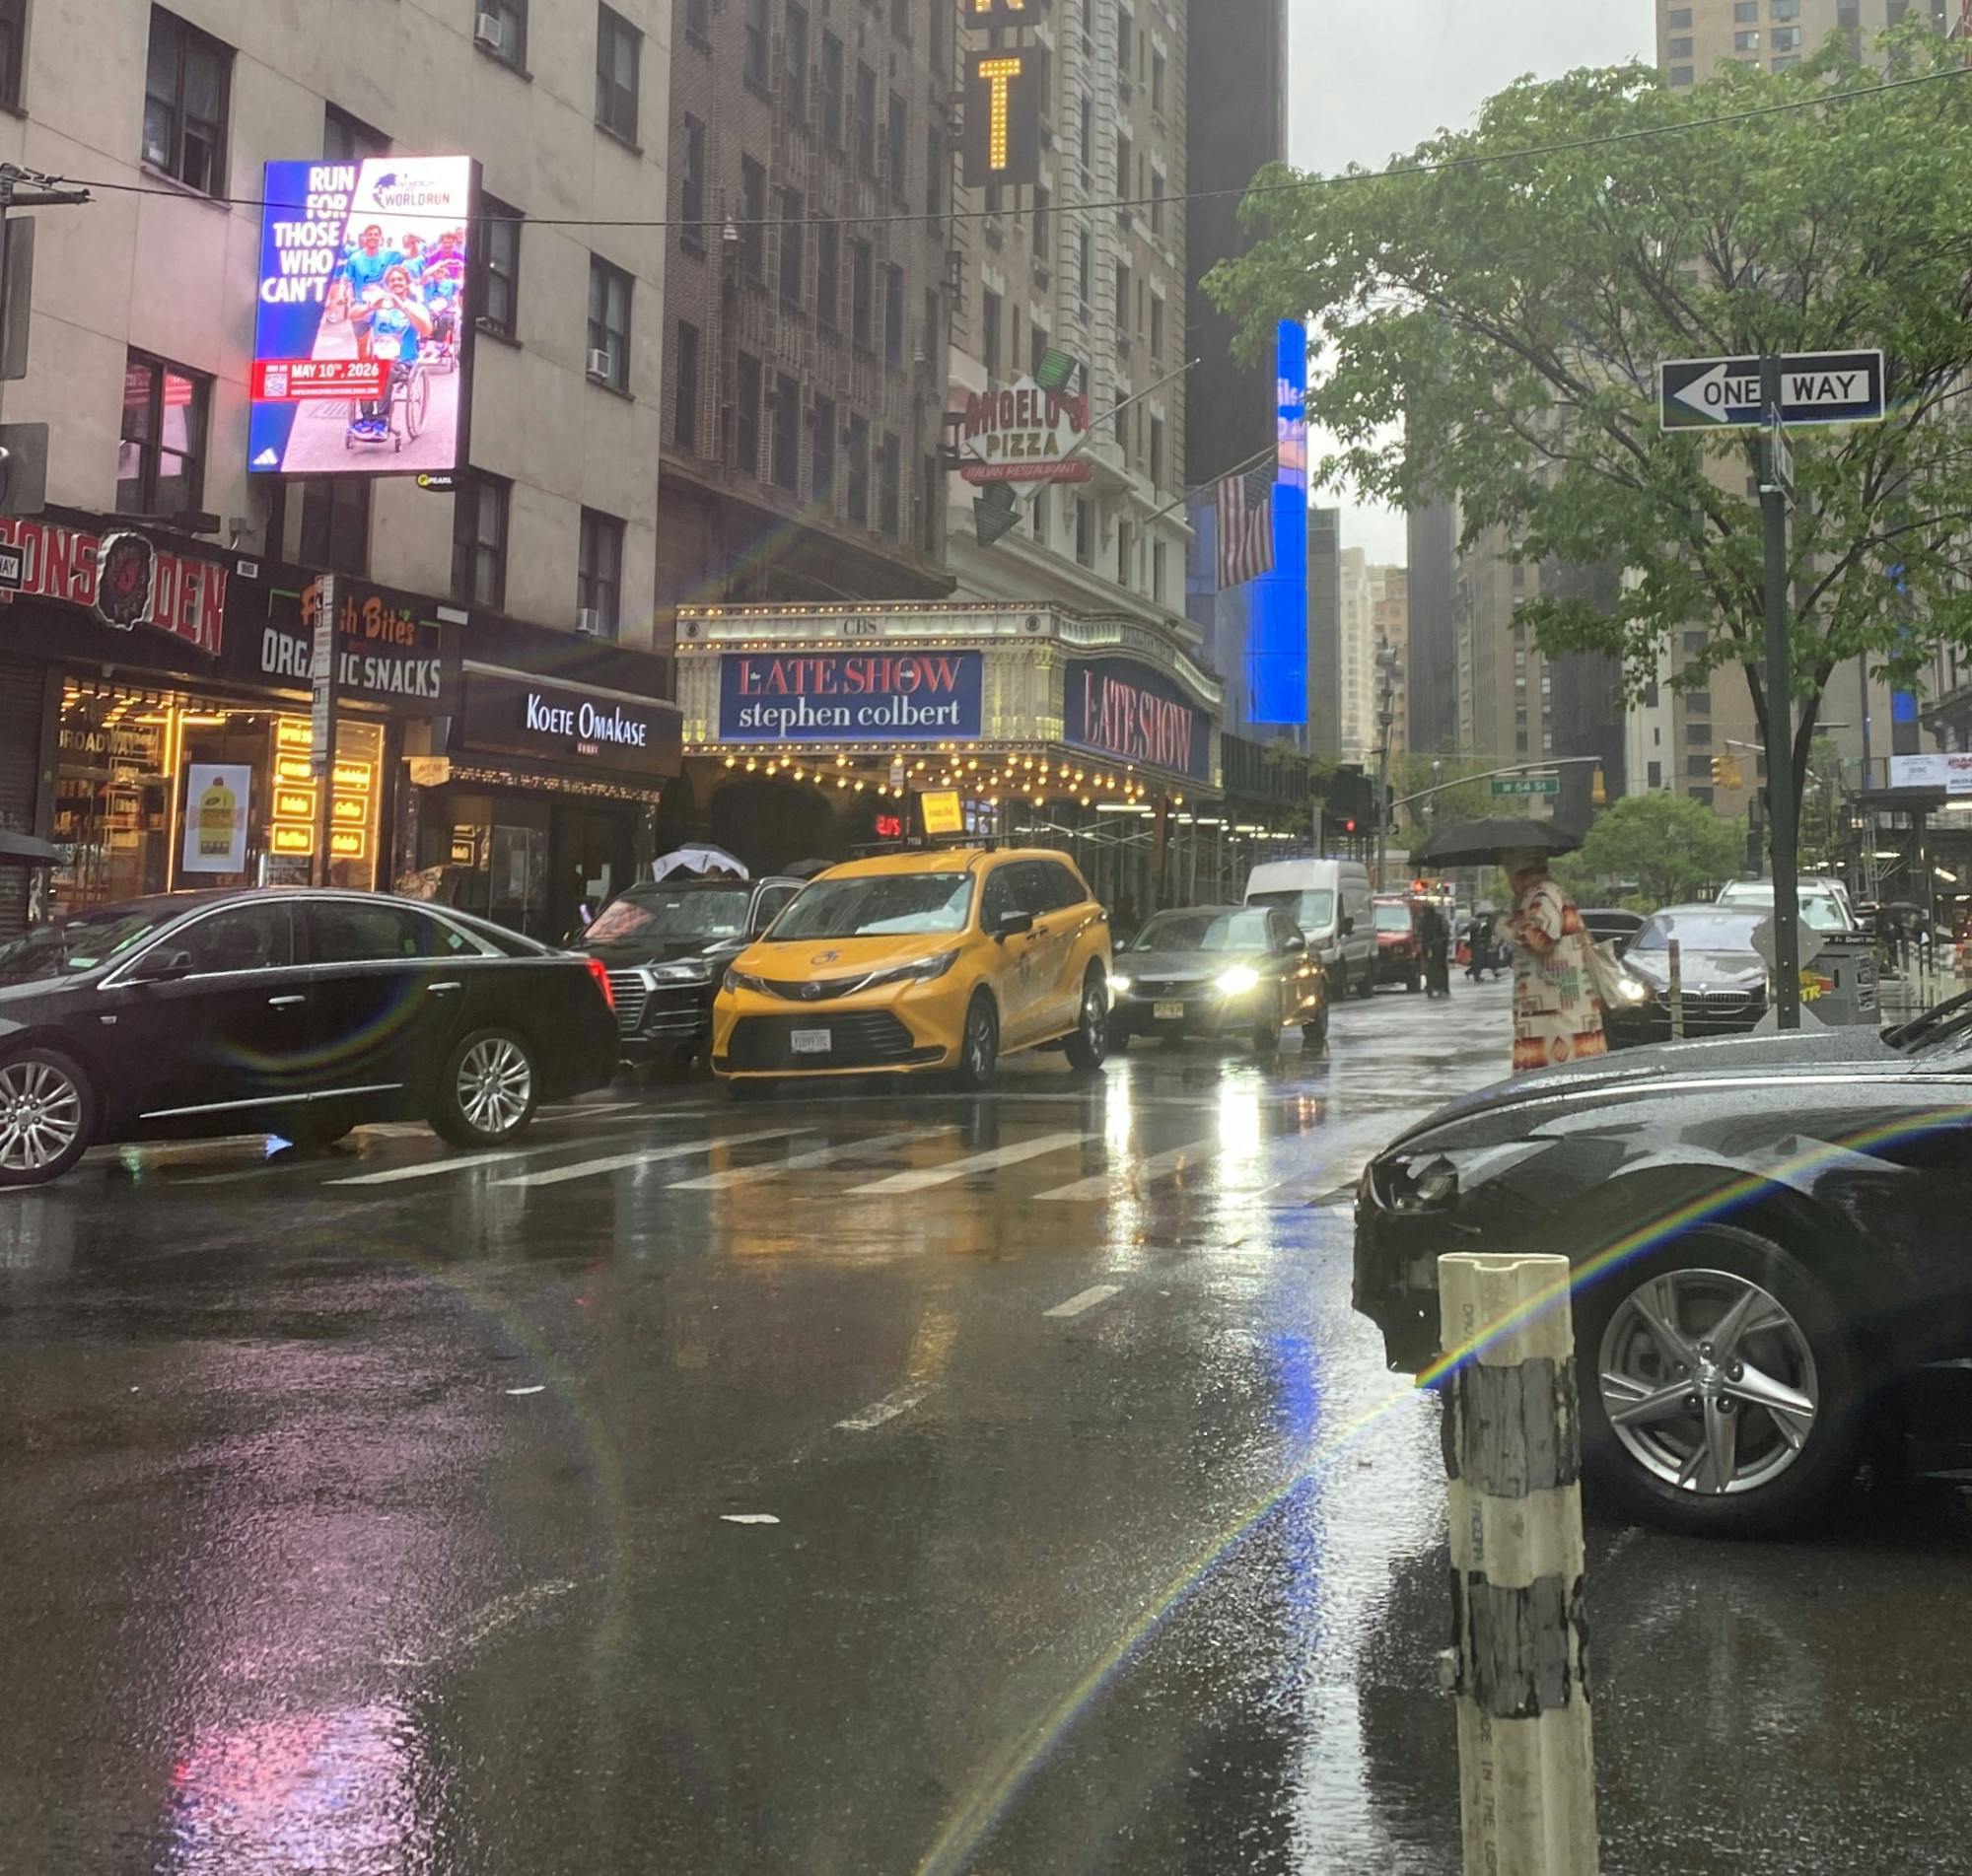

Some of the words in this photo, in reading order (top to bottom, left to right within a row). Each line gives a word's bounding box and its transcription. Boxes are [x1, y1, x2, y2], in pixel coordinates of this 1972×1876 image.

[310, 166, 355, 192] RUN
[306, 193, 349, 219] FOR
[273, 221, 341, 247] THOSE
[280, 248, 334, 275] WHO
[261, 276, 328, 303] CAN'T
[292, 365, 317, 379] MAY
[347, 363, 380, 378] 2026
[1704, 380, 1761, 405] ONE
[1793, 375, 1857, 401] WAY
[965, 389, 1089, 441] ANGELO'S
[987, 432, 1060, 458] PIZZA
[1007, 462, 1077, 477] RESTAURANT
[149, 552, 229, 658] DEN
[843, 617, 878, 635] CBS
[261, 627, 360, 686] ORGIC
[363, 656, 441, 699] SNACKS
[738, 658, 837, 695] LATE
[843, 656, 965, 695] SHOW
[739, 695, 852, 737] stephen
[858, 695, 961, 727] colbert
[1084, 669, 1137, 755] LATE
[1139, 691, 1192, 774] SHOW
